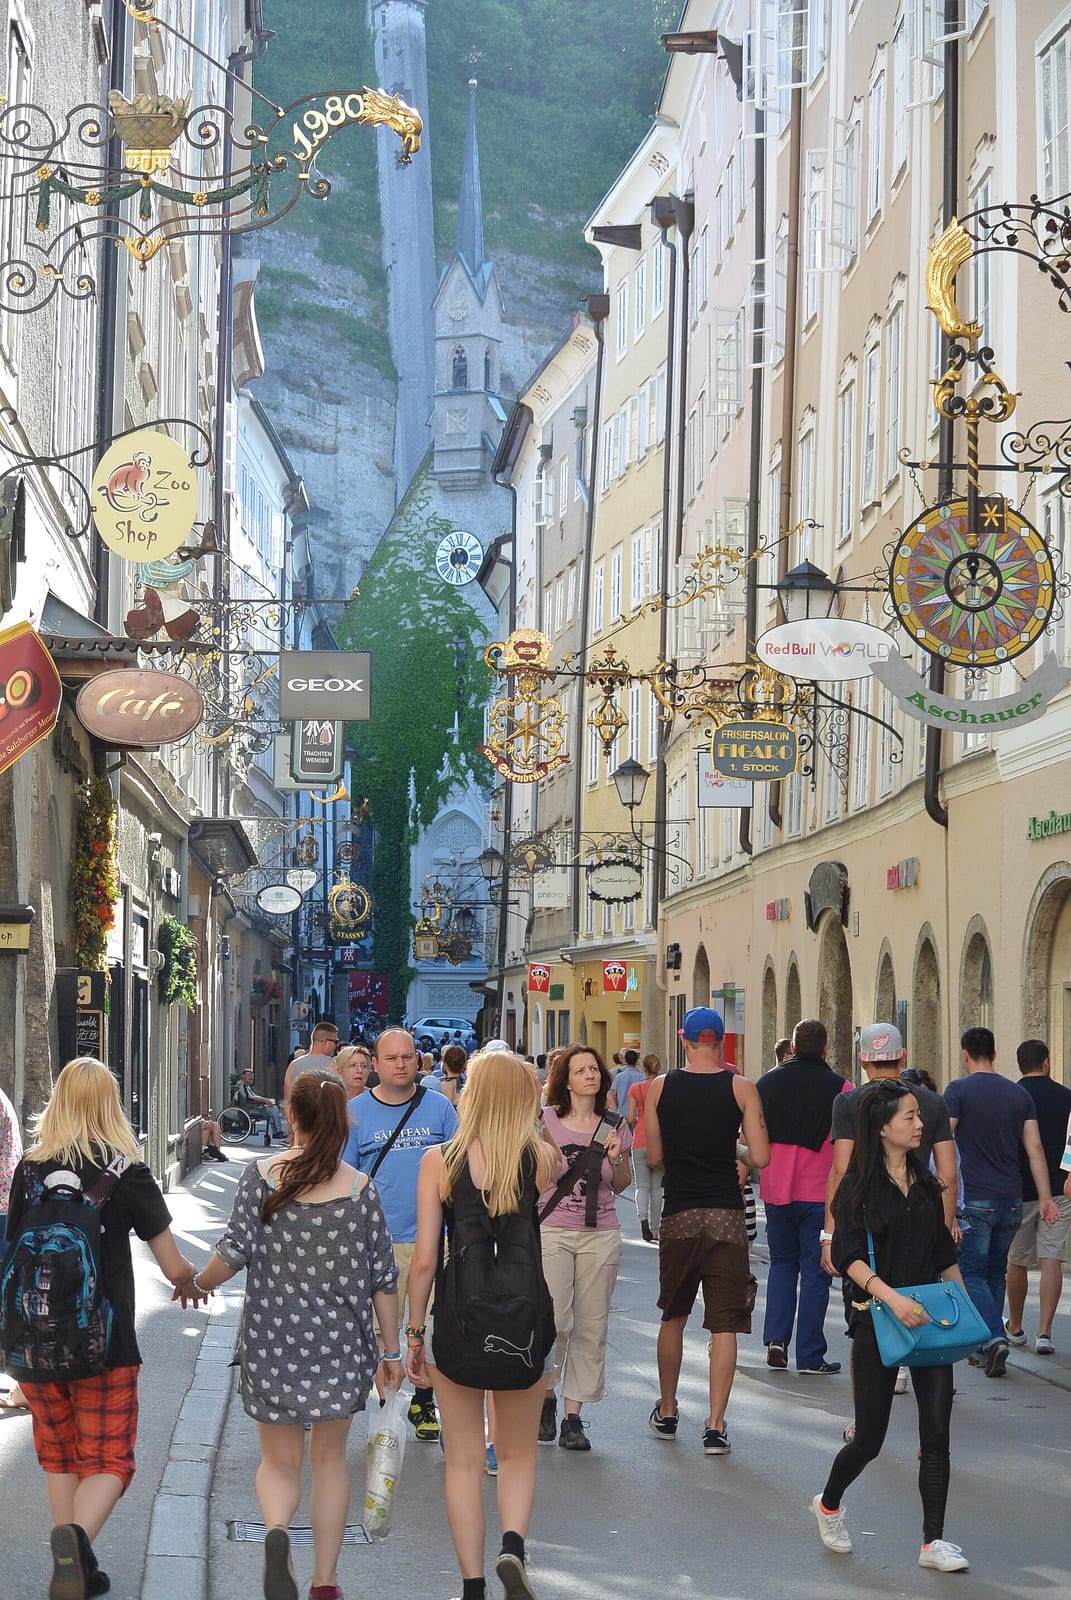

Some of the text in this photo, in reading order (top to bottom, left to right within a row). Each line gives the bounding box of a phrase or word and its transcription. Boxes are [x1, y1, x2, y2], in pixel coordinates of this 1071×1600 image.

[293, 94, 364, 161] 1980
[153, 471, 191, 490] Zoo
[115, 520, 158, 550] Shop
[764, 641, 790, 655] Red
[792, 641, 816, 656] Bull
[287, 678, 364, 692] GEOX
[96, 687, 184, 721] Café
[904, 690, 1043, 725] Aschauer
[721, 729, 790, 741] FRISIERSALON
[717, 743, 793, 761] FIGARO
[498, 763, 546, 783] Sternbräu
[729, 763, 779, 772] 1. STOCK
[336, 931, 366, 940] STASSNY
